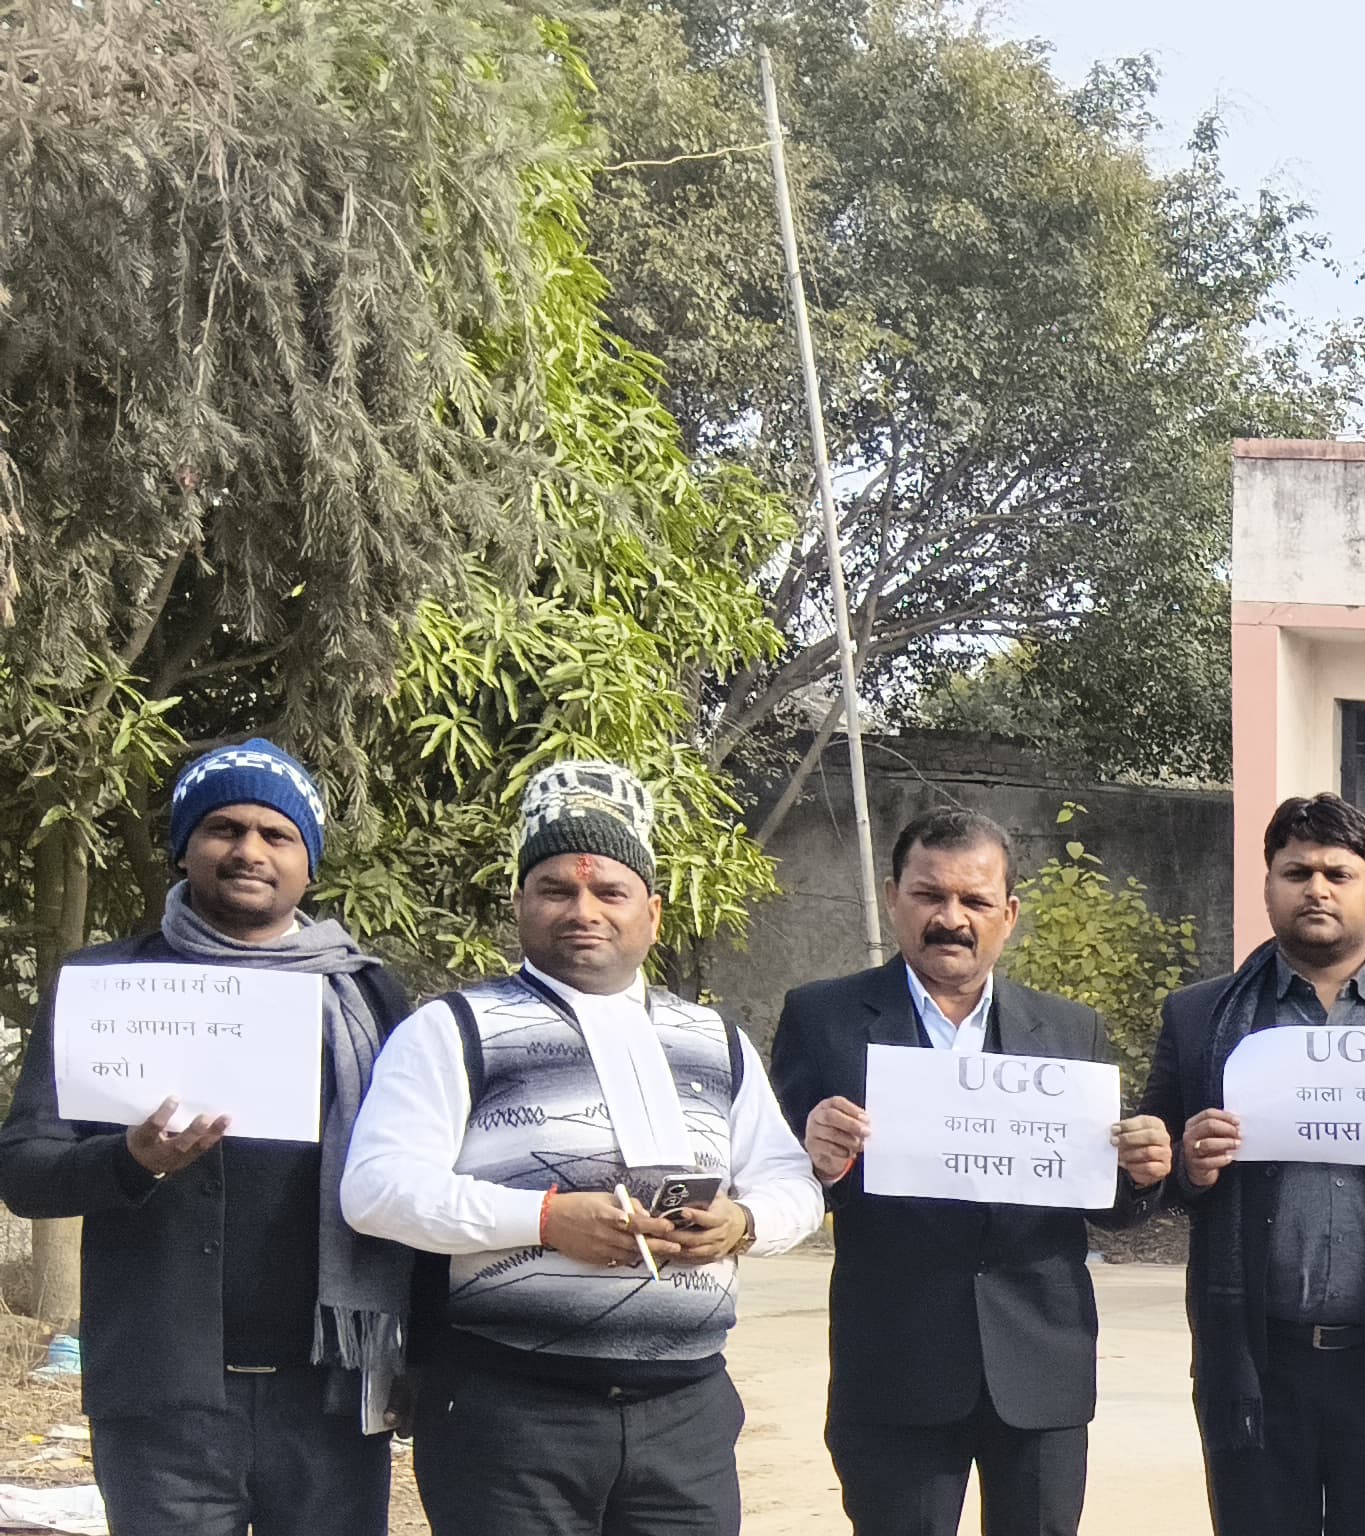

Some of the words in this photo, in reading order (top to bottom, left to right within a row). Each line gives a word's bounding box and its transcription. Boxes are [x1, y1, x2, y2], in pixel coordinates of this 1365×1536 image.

[90, 1018, 116, 1034] का
[126, 1019, 196, 1036] अपमान
[206, 1022, 244, 1039] बन्द
[958, 1056, 1066, 1096] UGC
[1295, 1086, 1343, 1103] काला
[944, 1115, 996, 1134] काला
[1009, 1119, 1068, 1143] कानून
[1295, 1121, 1363, 1142] वापस
[942, 1152, 1015, 1177] वापस
[1031, 1150, 1066, 1179] लो
